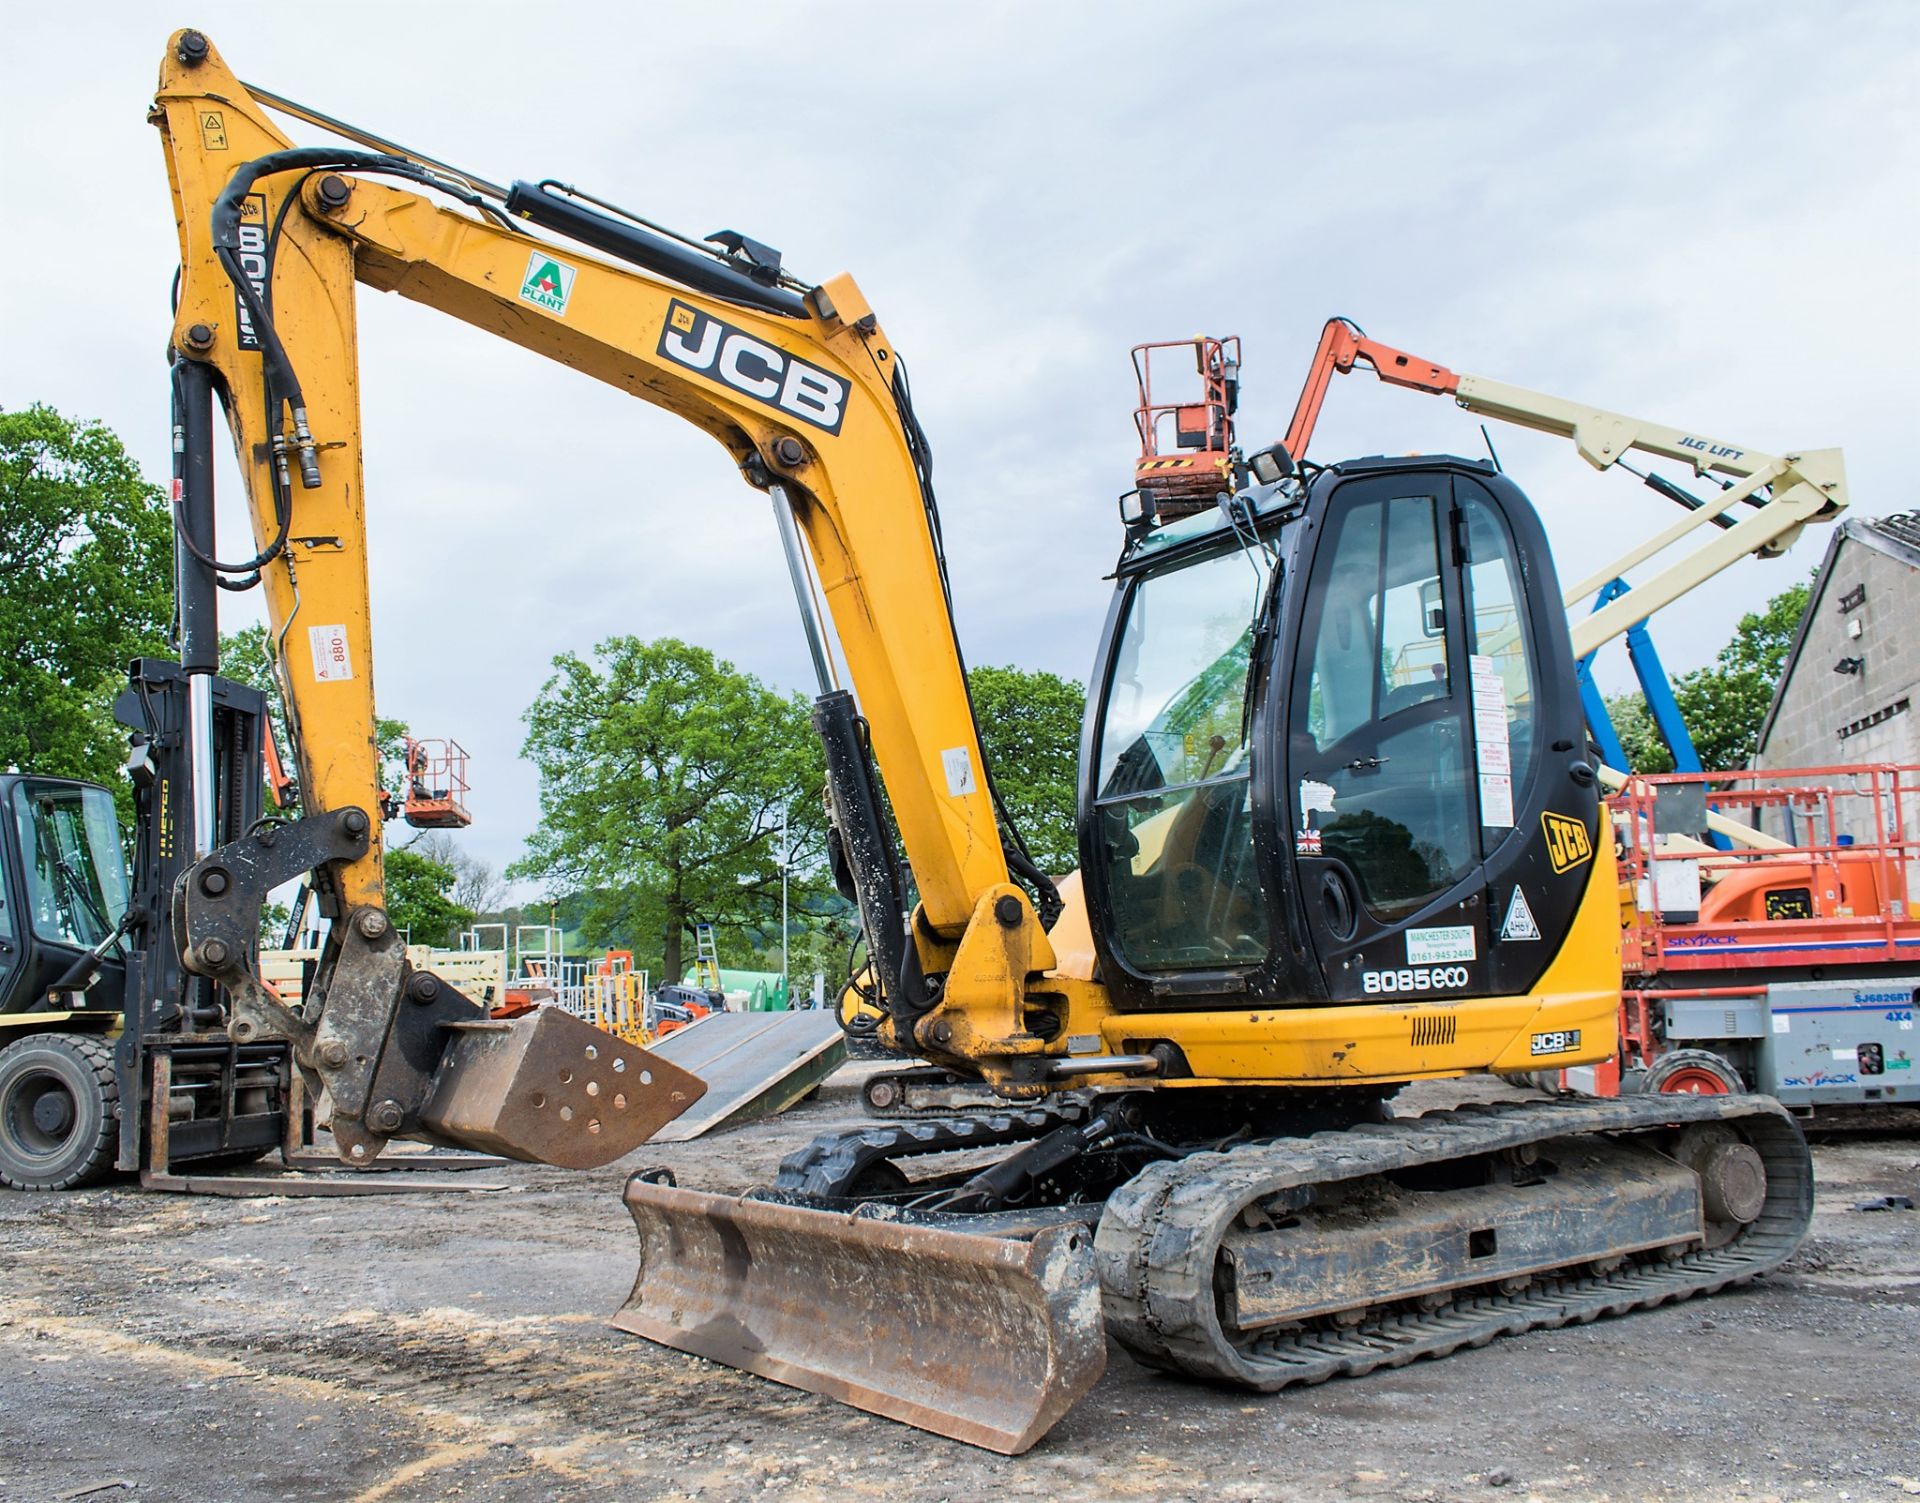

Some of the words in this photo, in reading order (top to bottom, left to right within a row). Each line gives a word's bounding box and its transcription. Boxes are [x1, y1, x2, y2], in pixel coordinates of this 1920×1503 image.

[521, 286, 565, 311] PLANT
[665, 319, 843, 427] JCB
[1677, 437, 1707, 450] JLG
[1709, 445, 1744, 460] LIFT
[331, 638, 345, 662] 880
[1548, 819, 1588, 867] JCB
[1668, 933, 1738, 947] SKYJACK
[1531, 1033, 1565, 1050] JCB
[1783, 1070, 1857, 1087] SKYJACK
